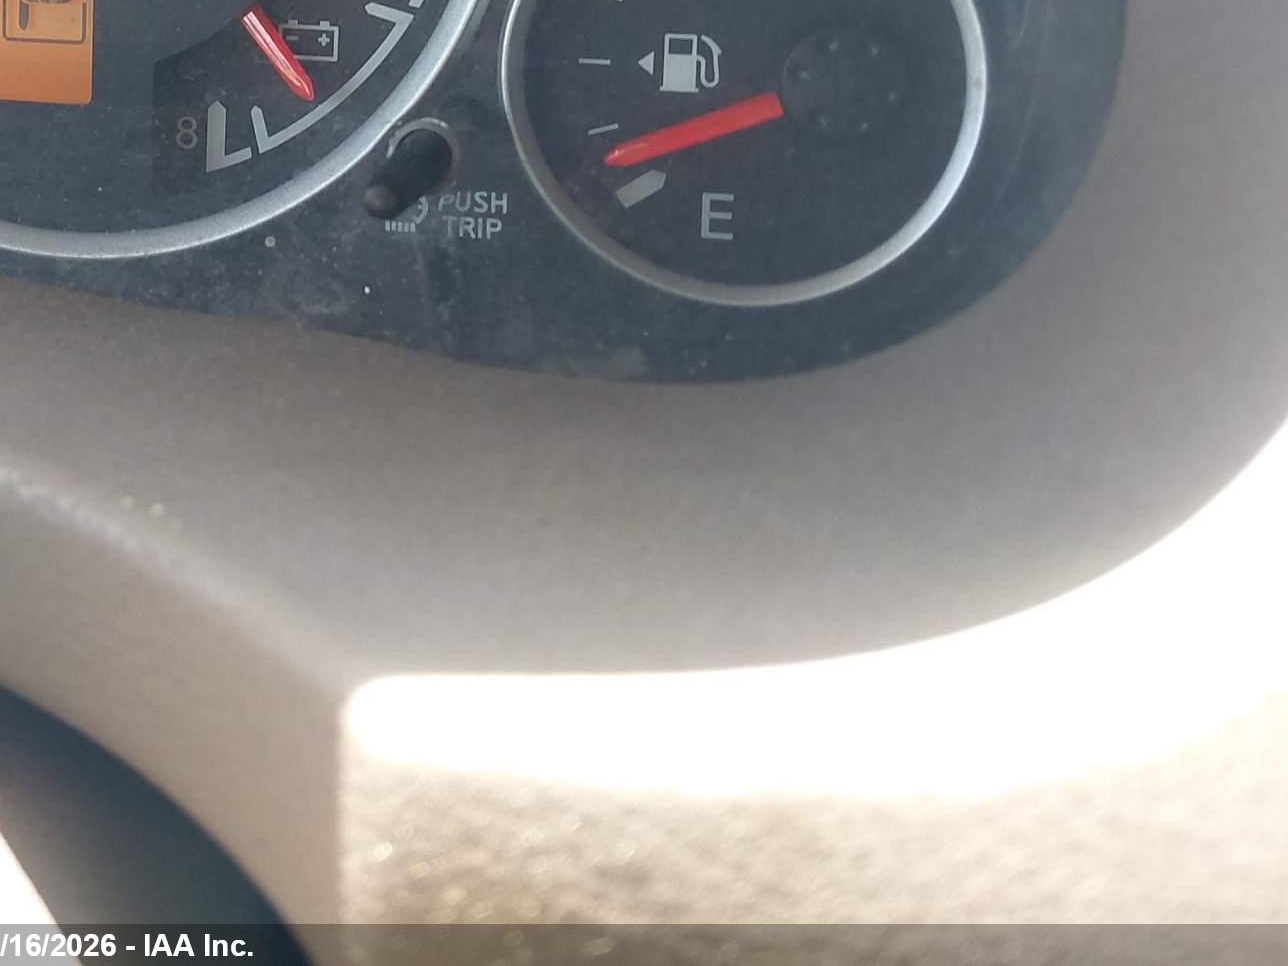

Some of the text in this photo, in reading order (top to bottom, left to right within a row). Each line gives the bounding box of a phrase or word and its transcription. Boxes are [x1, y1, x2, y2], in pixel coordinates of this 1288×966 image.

[176, 117, 198, 149] 8
[438, 191, 508, 214] PUSH
[700, 192, 735, 241] E
[442, 214, 503, 240] TRIP
